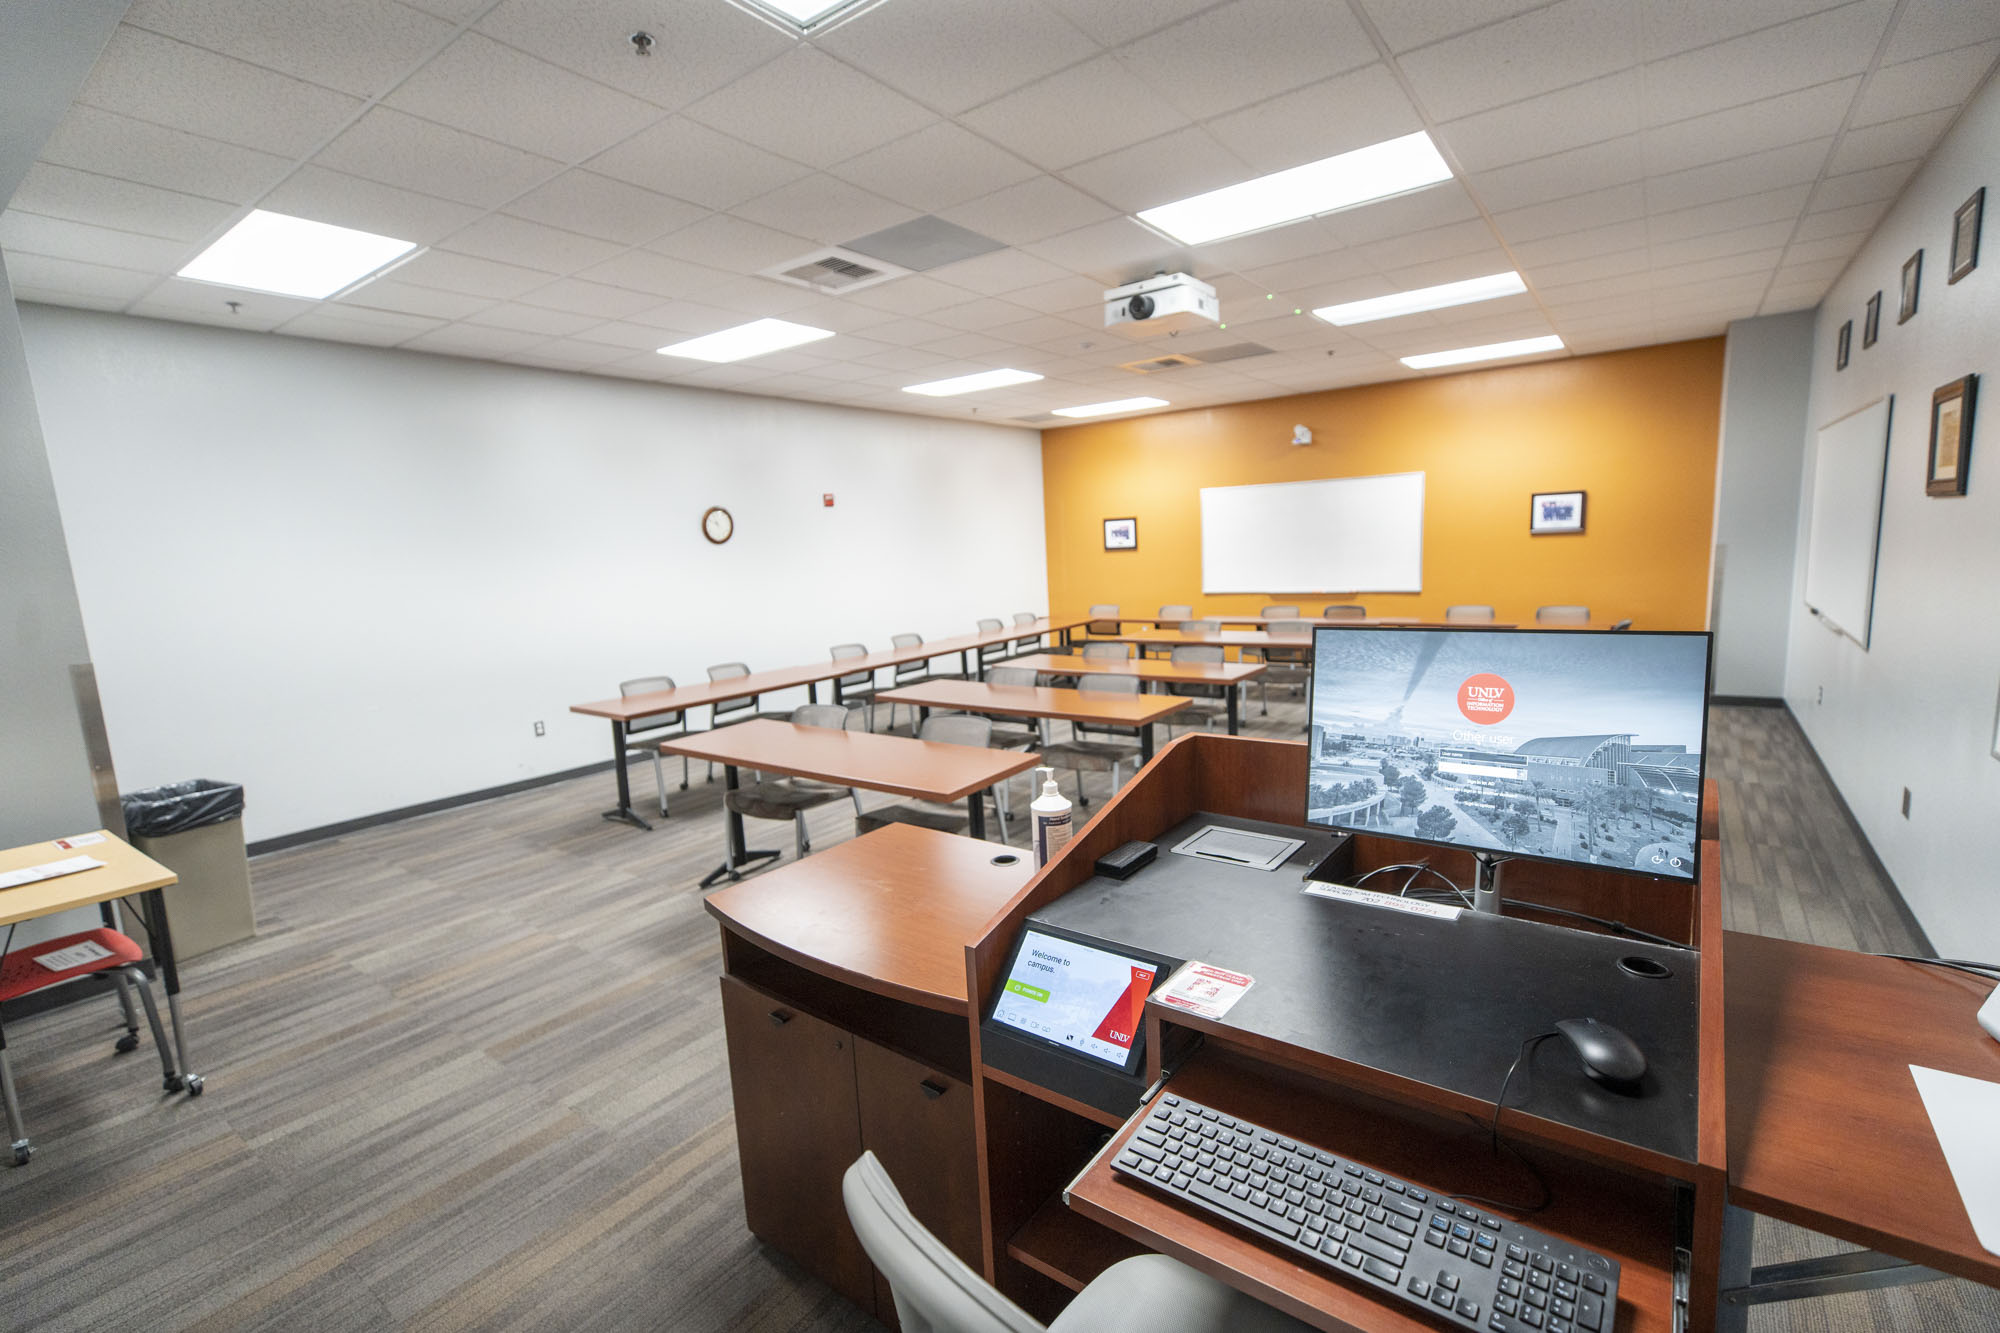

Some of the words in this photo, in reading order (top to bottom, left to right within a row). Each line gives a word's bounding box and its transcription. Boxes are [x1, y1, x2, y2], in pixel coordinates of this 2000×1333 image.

[1467, 686, 1504, 698] UNLV
[1452, 729, 1485, 742] Other
[1489, 734, 1513, 744] user
[1373, 893, 1432, 907] TECHNOLOGY
[1031, 949, 1062, 964] Welcome
[1063, 958, 1071, 967] to
[1027, 960, 1055, 974] campus.
[1109, 1029, 1131, 1043] UNLV
